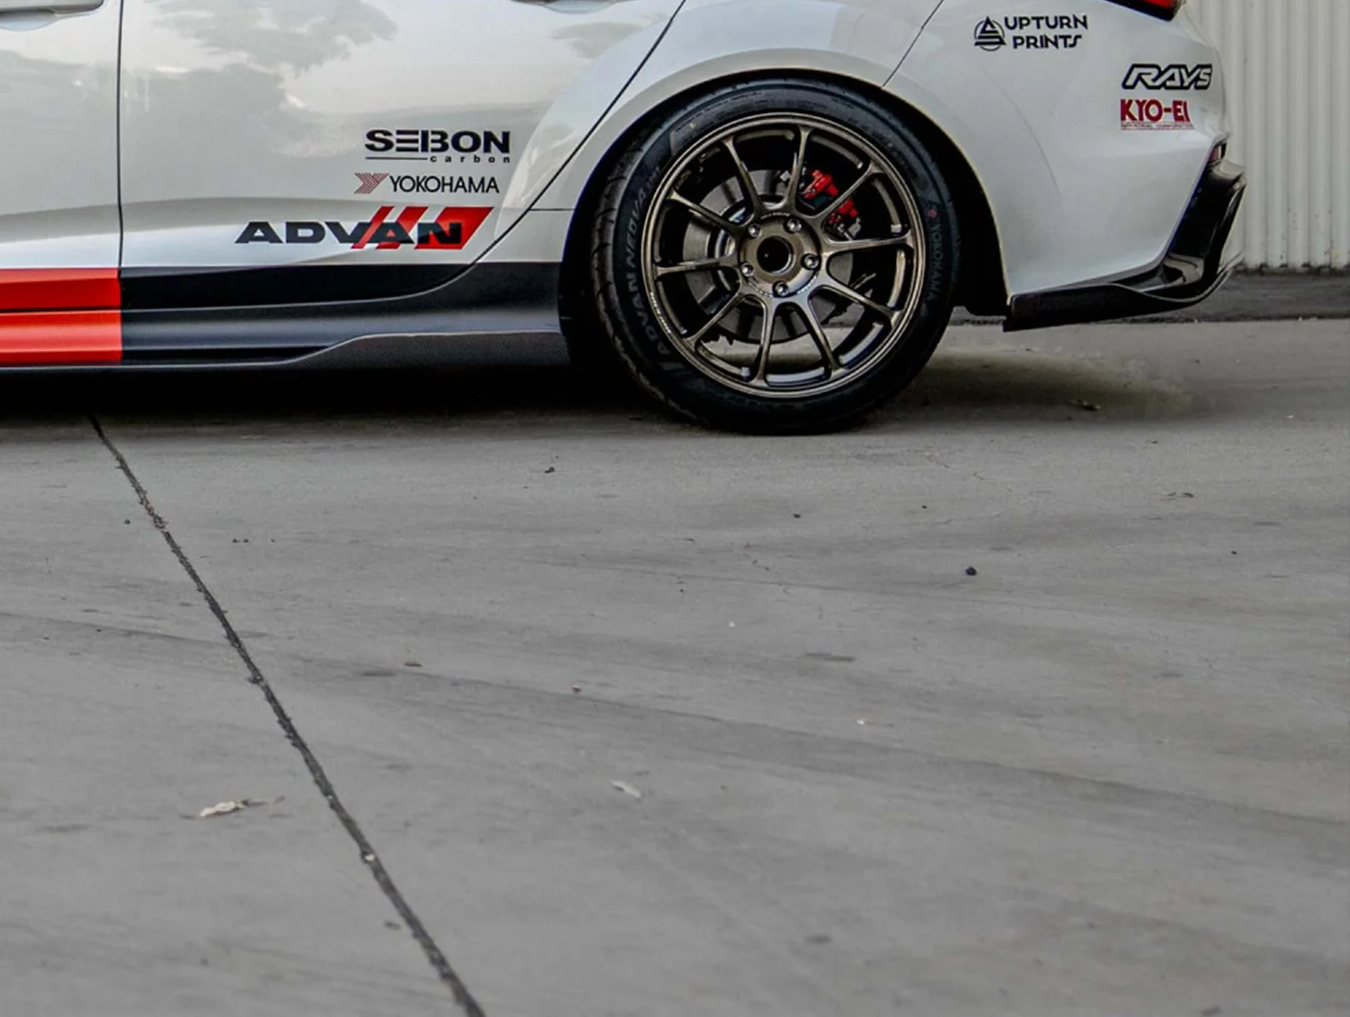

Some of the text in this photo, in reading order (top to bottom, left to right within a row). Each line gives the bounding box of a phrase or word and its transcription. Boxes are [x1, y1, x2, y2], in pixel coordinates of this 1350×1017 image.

[1004, 15, 1088, 31] UPTURN
[1012, 34, 1082, 50] PRINTS
[1121, 63, 1212, 90] RAYS
[1120, 99, 1190, 122] KYO-EI
[365, 129, 511, 154] SEIBON
[430, 154, 511, 164] carbon
[389, 175, 500, 194] YOKOHAMA
[235, 221, 463, 244] ADVAN
